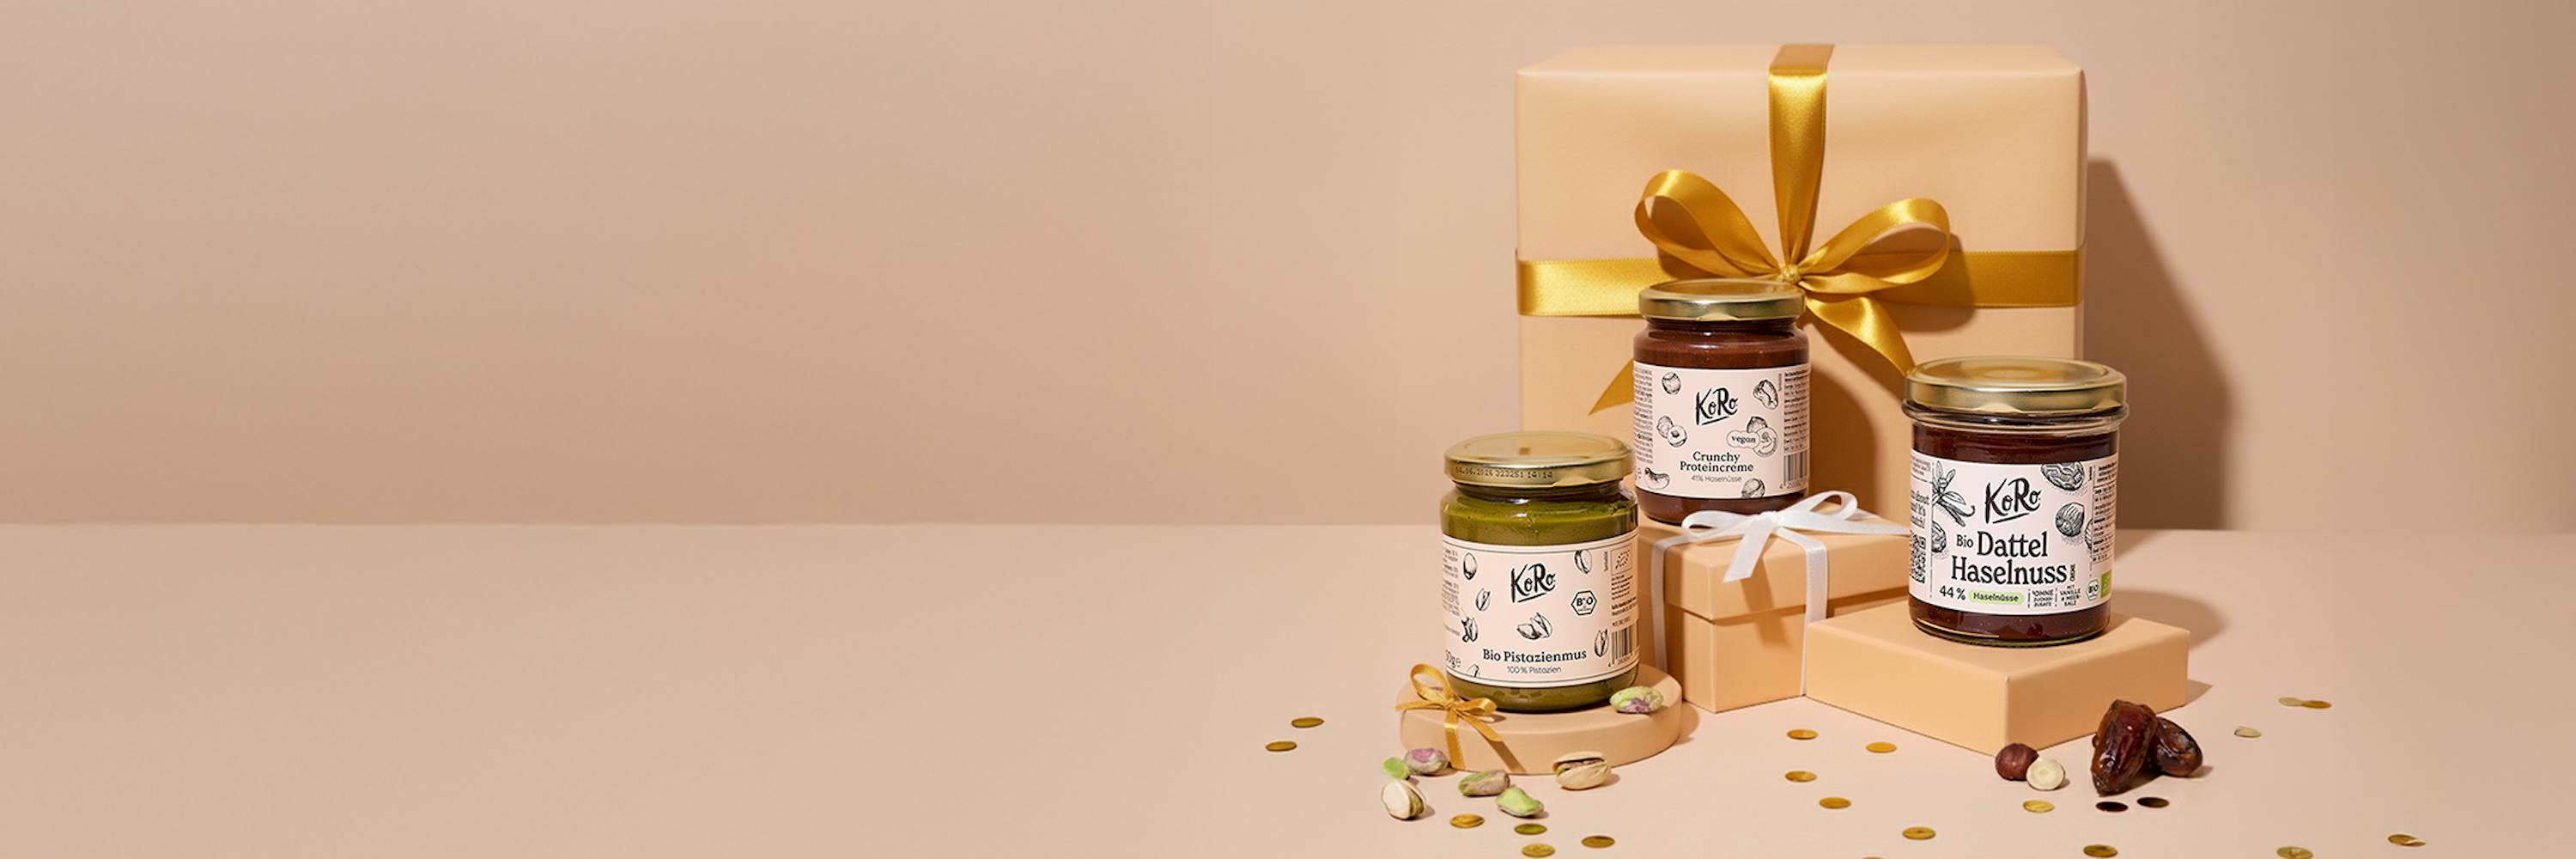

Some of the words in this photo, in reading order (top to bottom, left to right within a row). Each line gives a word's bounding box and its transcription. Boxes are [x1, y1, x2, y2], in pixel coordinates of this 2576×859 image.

[1695, 387, 1738, 425] KoRo
[1731, 436, 1756, 444] vegan
[1692, 450, 1741, 465] Crunchy
[1985, 478, 2040, 524] KoRo
[1956, 534, 1973, 548] Bio
[1977, 531, 2048, 557] Dattel
[1951, 555, 2068, 585] Haselnuss
[1510, 563, 1556, 603] KoRo
[1939, 585, 1954, 599] 44
[1973, 592, 2019, 602] Haselnüsse
[1483, 649, 1501, 661] Bio
[1504, 650, 1587, 663] Pistazienmus
